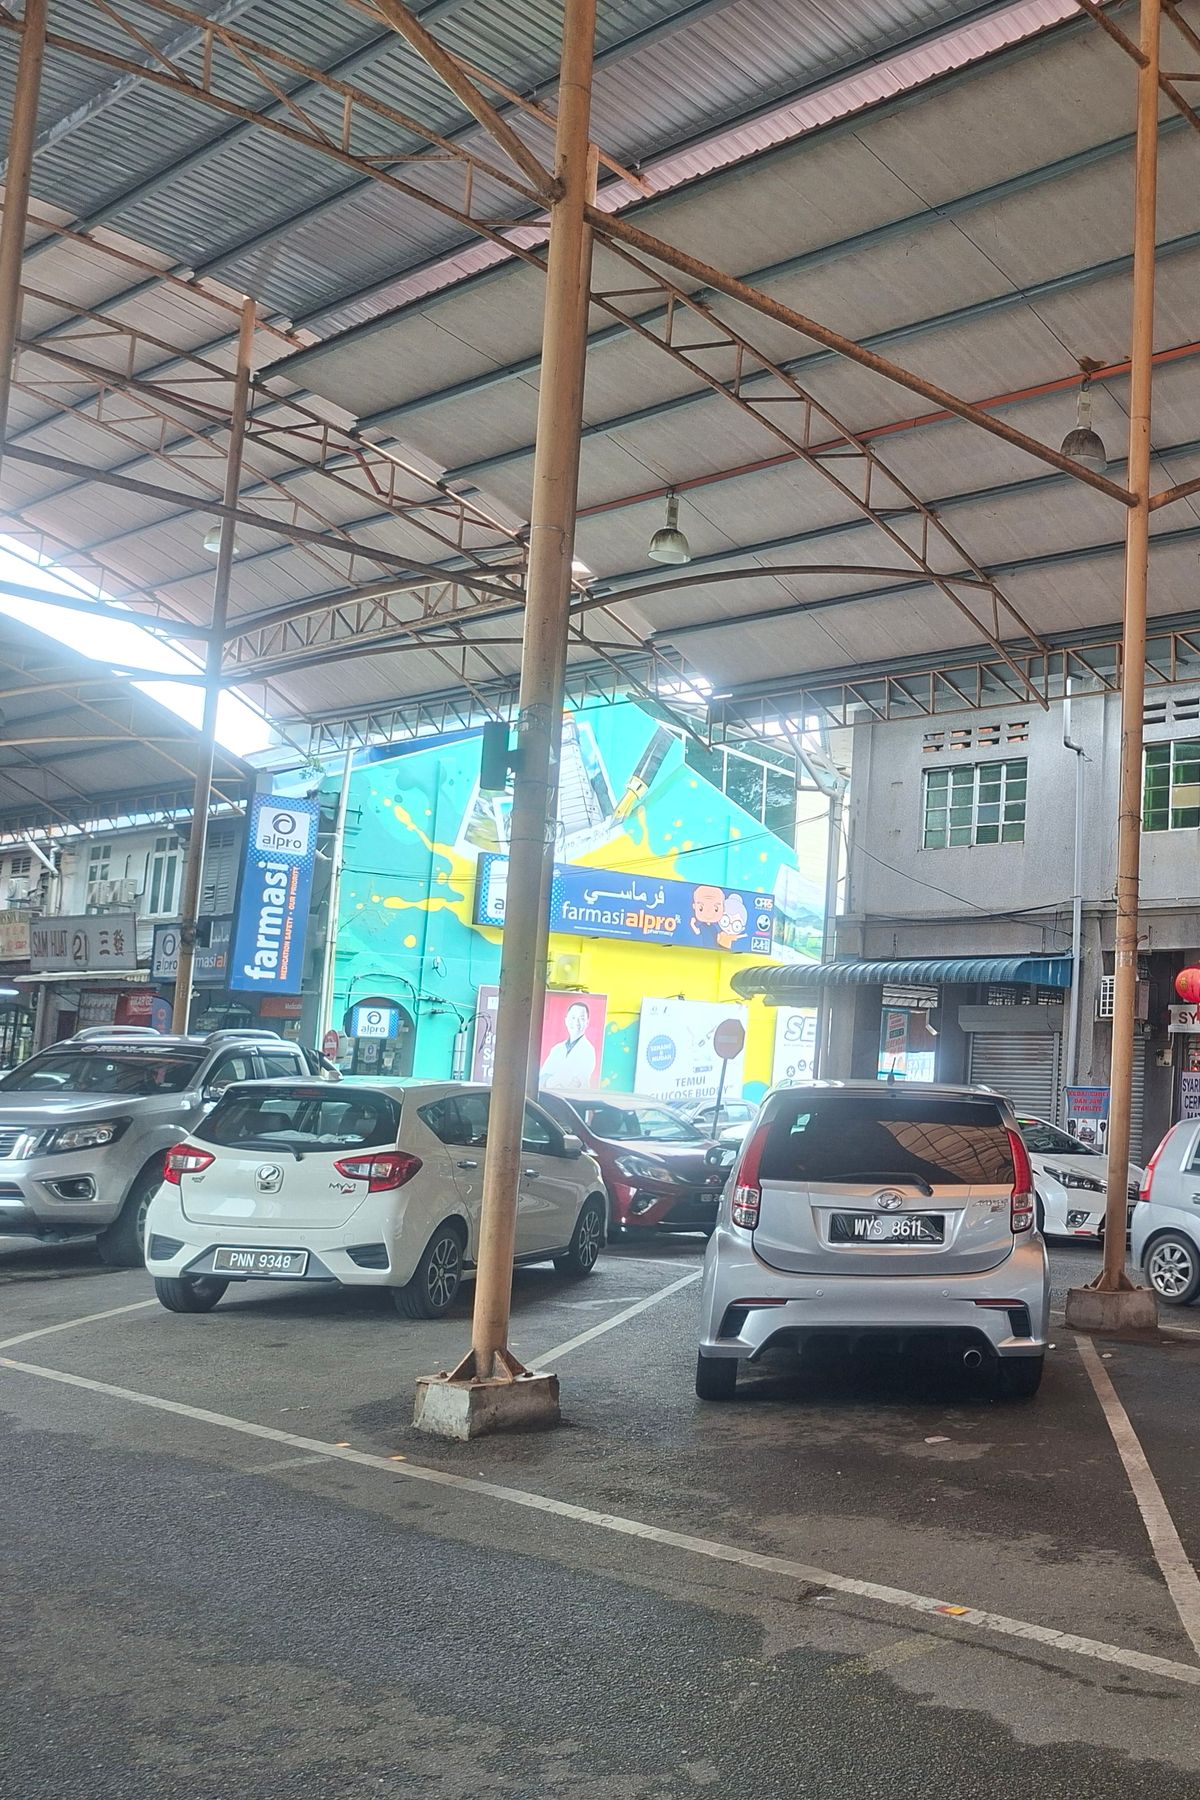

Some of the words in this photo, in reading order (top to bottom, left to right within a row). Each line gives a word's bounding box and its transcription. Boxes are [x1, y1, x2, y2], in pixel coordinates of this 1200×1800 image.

[262, 834, 302, 850] alpro
[244, 861, 290, 981] farmasi
[360, 1025, 386, 1035] alpro
[675, 1076, 706, 1087] TEMUI
[695, 1085, 729, 1098] BUDY
[854, 1218, 883, 1236] WYS
[891, 1219, 922, 1236] 8611
[229, 1252, 255, 1267] PNN
[258, 1254, 292, 1269] 9348
